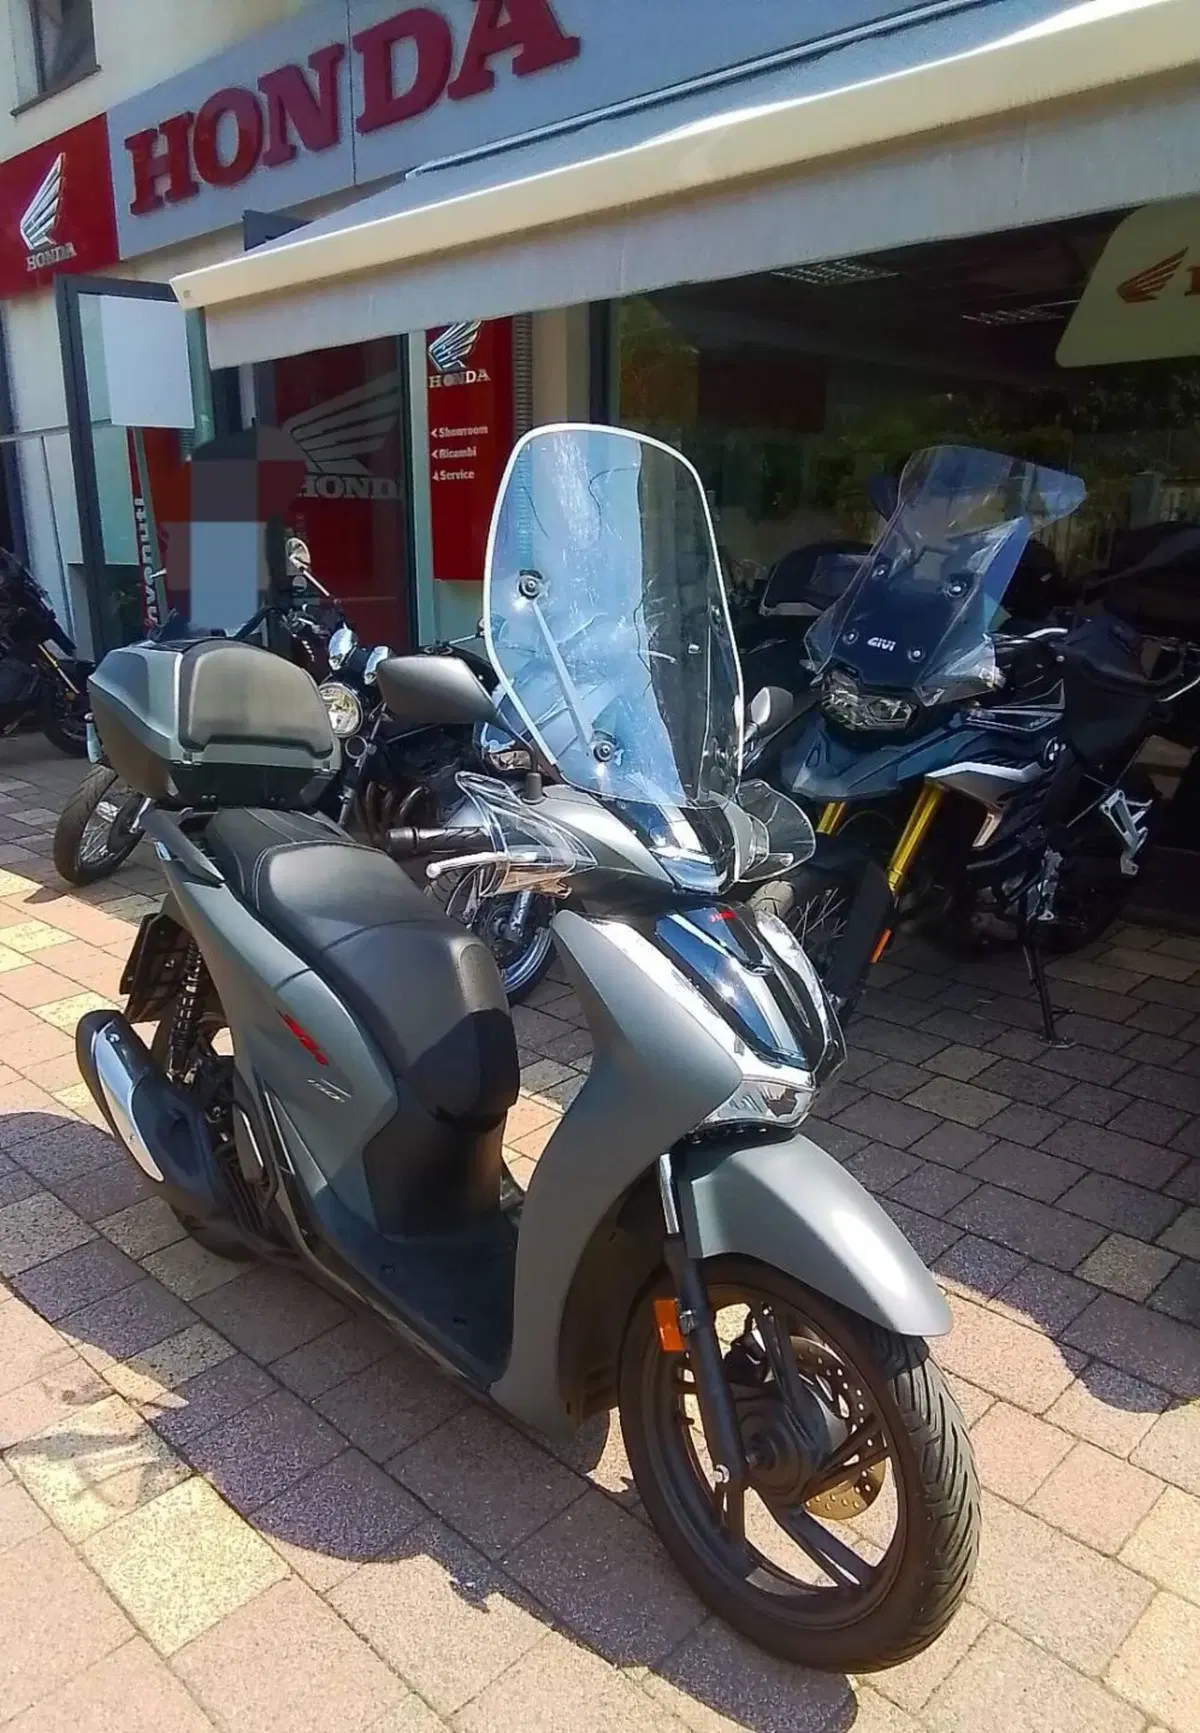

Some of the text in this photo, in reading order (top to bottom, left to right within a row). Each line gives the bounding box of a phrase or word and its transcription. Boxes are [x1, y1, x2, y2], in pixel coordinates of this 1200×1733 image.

[124, 0, 581, 217] HONDA
[26, 242, 78, 272] HONDA
[429, 368, 491, 388] HONDA
[438, 425, 489, 438] Showroom
[439, 445, 477, 459] Ricambi
[440, 469, 475, 481] Service
[296, 474, 402, 500] HOND
[867, 636, 897, 652] GIVI
